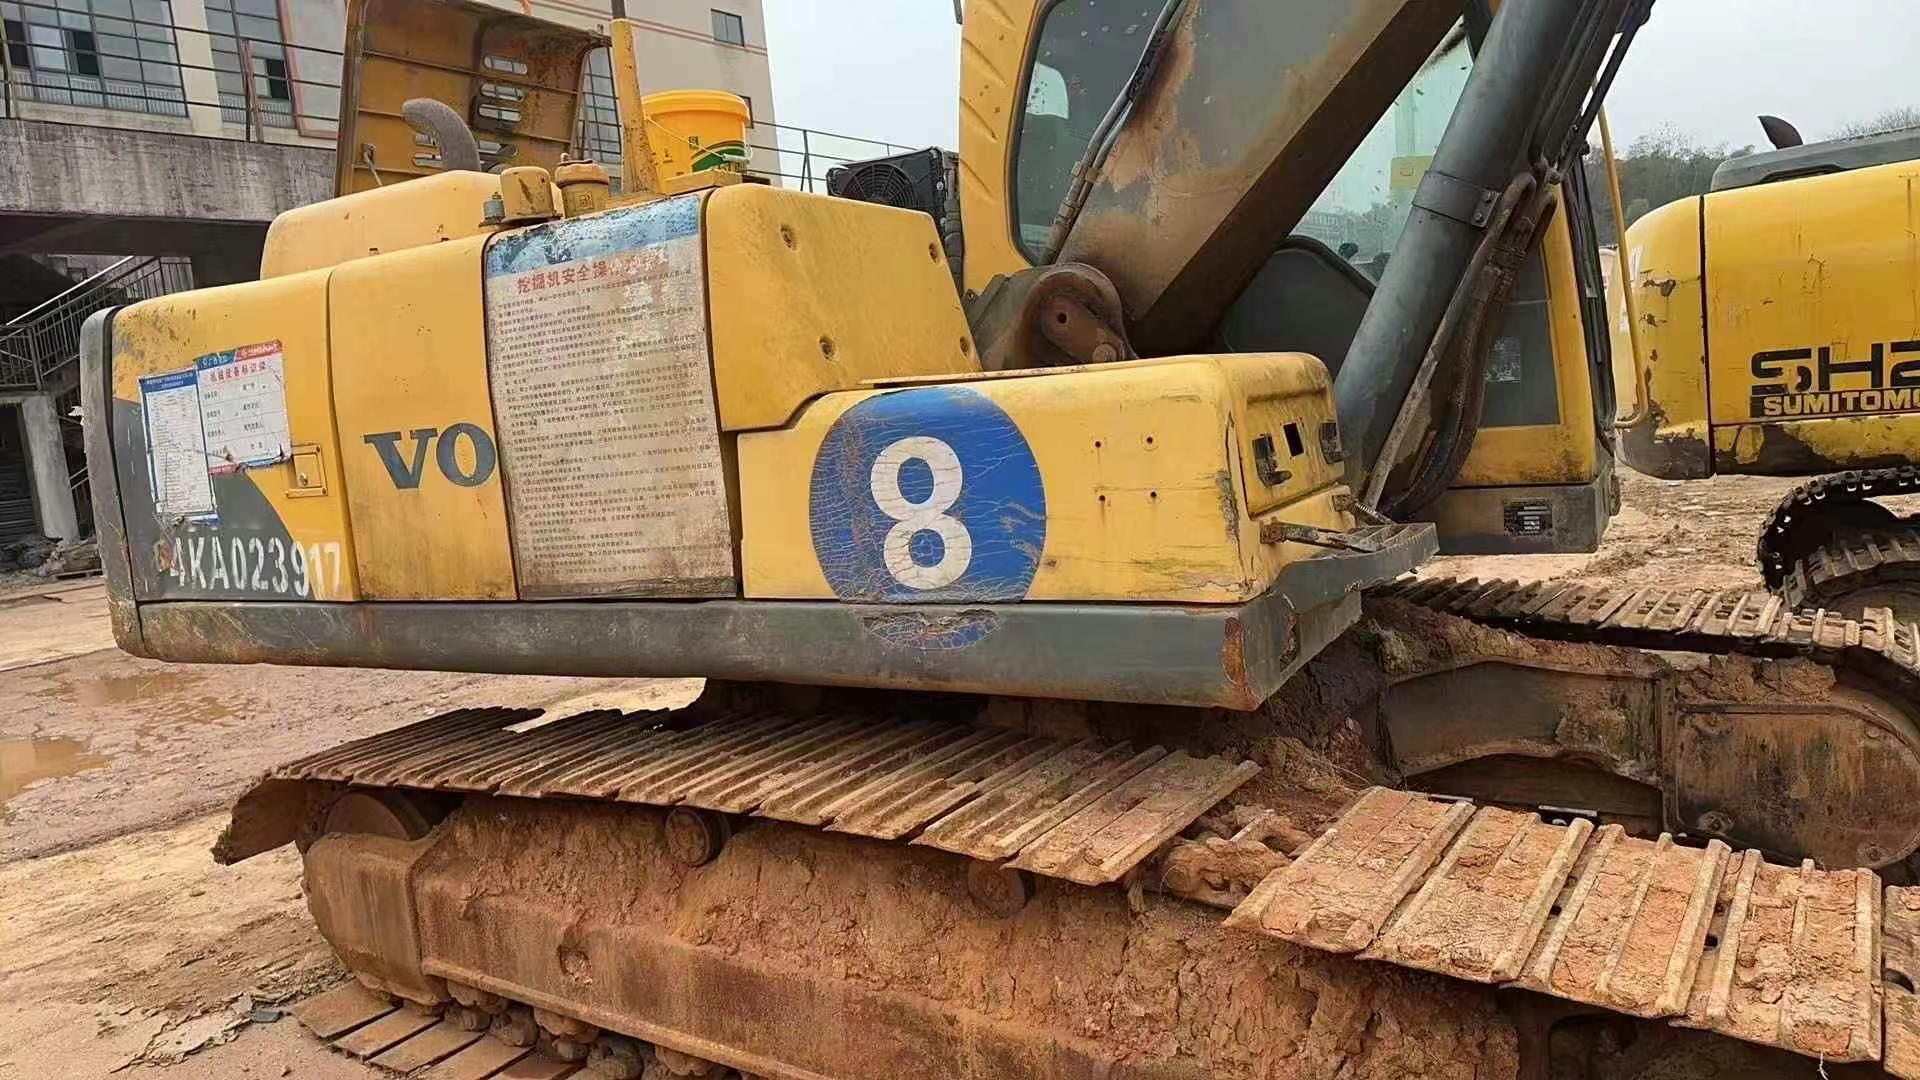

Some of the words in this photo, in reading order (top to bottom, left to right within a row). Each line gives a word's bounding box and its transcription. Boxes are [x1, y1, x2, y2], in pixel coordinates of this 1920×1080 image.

[517, 247, 667, 294] 挖掘机安全操
[364, 422, 496, 489] VO
[870, 436, 972, 589] 8
